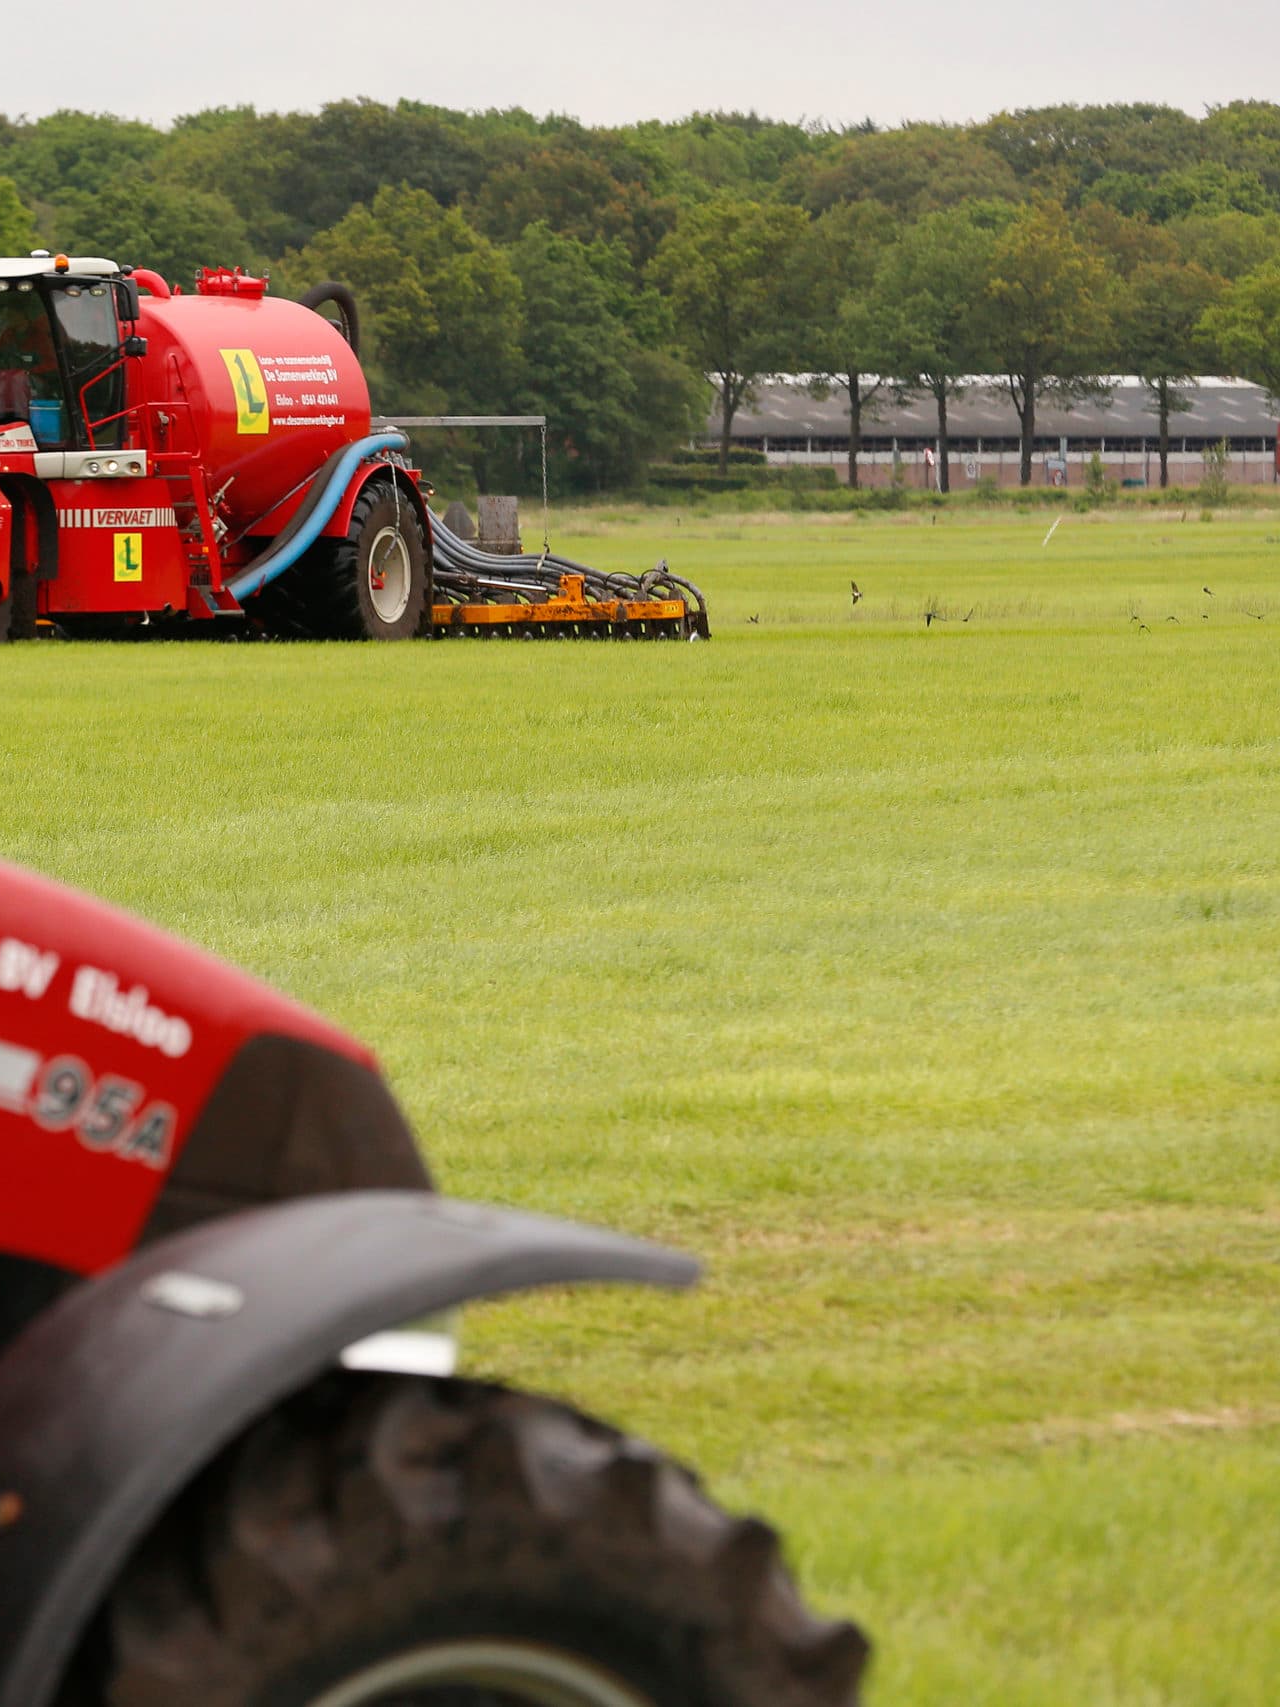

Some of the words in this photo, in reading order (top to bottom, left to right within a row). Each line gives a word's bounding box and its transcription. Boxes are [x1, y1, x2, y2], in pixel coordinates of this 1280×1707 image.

[264, 369, 276, 382] De
[275, 369, 328, 384] Samenwerking
[326, 369, 337, 381] BV
[97, 510, 153, 525] VERVAET
[30, 1054, 178, 1172] 95A
